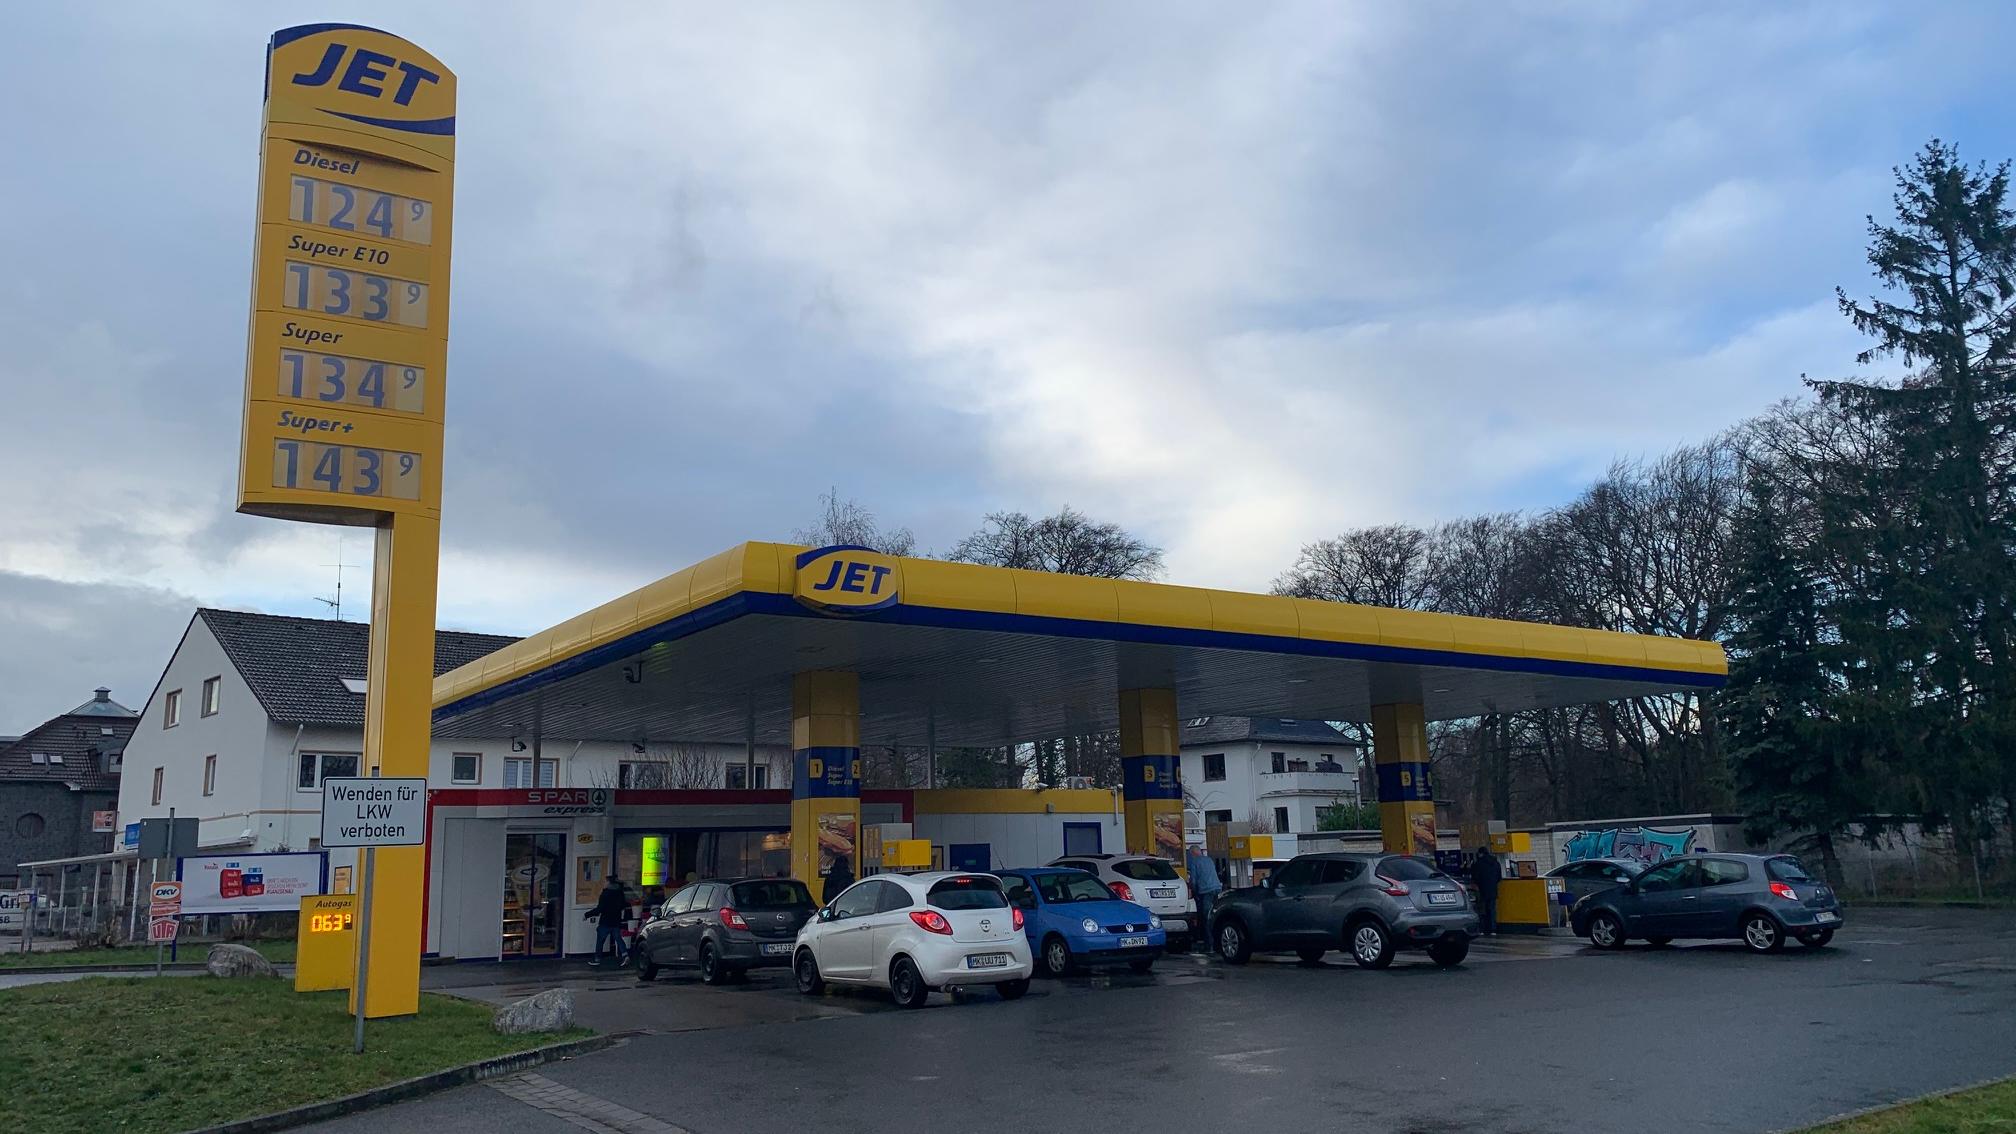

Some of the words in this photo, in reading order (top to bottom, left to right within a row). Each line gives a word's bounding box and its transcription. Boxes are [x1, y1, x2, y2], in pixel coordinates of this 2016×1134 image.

[291, 43, 441, 107] JET
[293, 149, 360, 175] Diesel
[288, 235, 349, 258] Super
[353, 246, 389, 265] E10
[282, 322, 343, 344] Super
[277, 410, 354, 433] Super+
[813, 560, 892, 595] JET
[332, 786, 392, 801] Wenden
[397, 786, 418, 801] für
[528, 791, 589, 803] SPAR
[357, 804, 393, 819] LKW
[543, 806, 605, 815] express
[340, 822, 405, 838] verboten
[155, 888, 178, 896] DKV
[315, 900, 352, 909] Autogas
[153, 922, 178, 939] UTA
